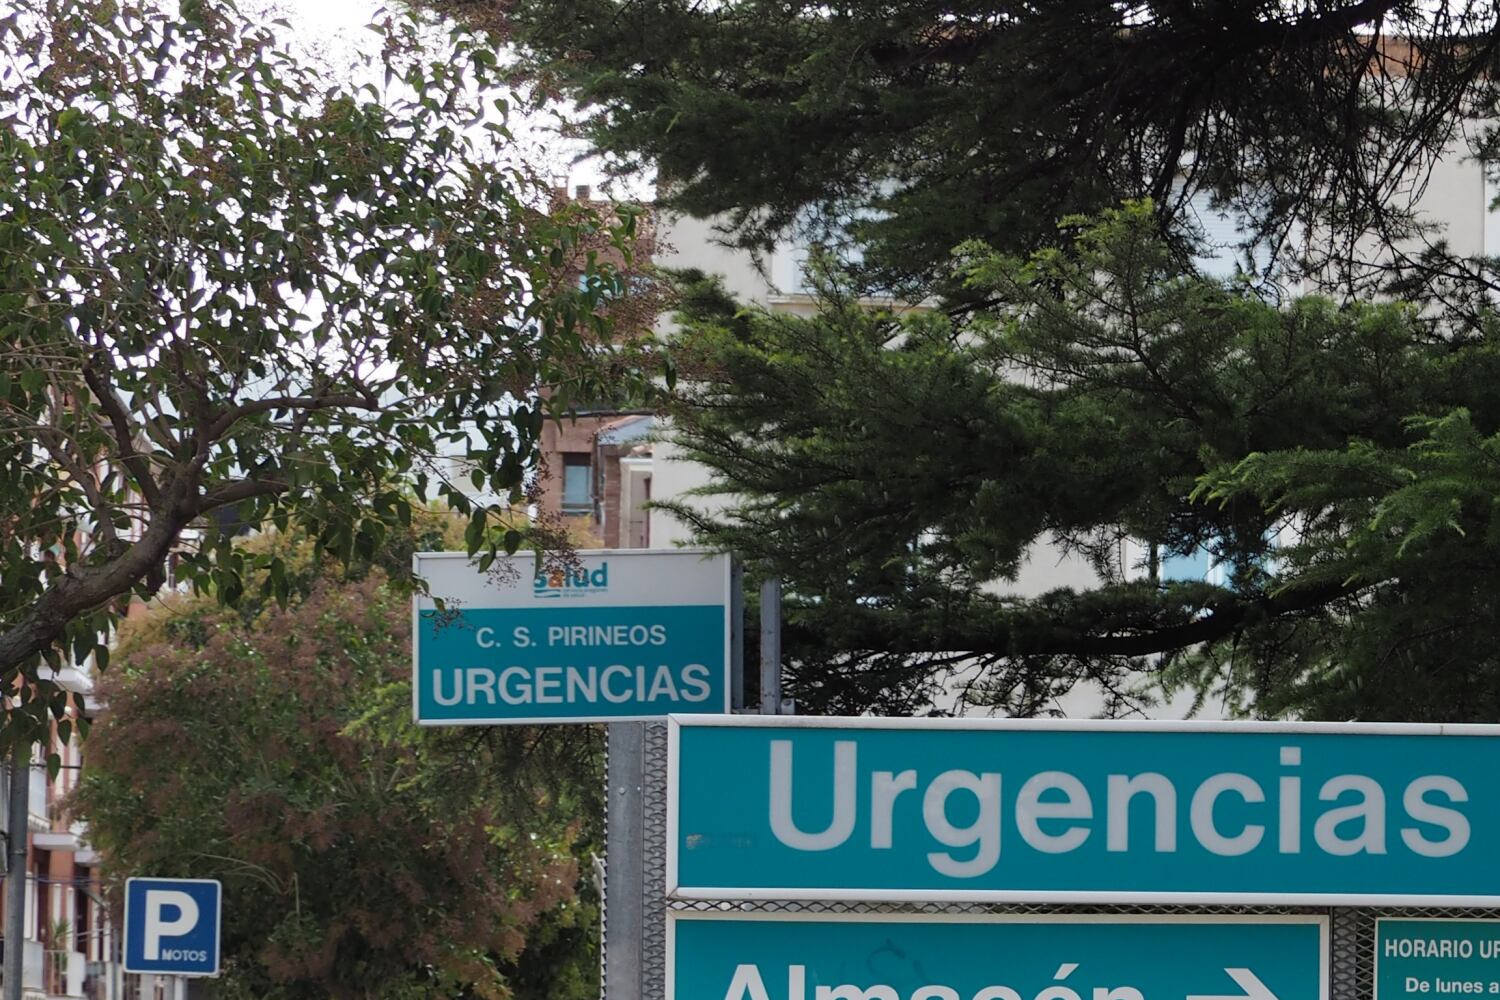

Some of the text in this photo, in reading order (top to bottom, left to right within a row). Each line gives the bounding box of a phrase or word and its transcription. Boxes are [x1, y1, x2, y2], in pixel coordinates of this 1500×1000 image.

[476, 625, 667, 648] C. S. PIRINEOS
[432, 664, 711, 706] URGENCIAS
[767, 739, 1473, 878] Urgencias
[144, 889, 199, 960] P
[161, 948, 207, 962] MOTOS
[1384, 939, 1473, 958] HORARIO
[1405, 977, 1430, 993] De
[1435, 978, 1484, 993] lunes
[1488, 981, 1500, 993] a
